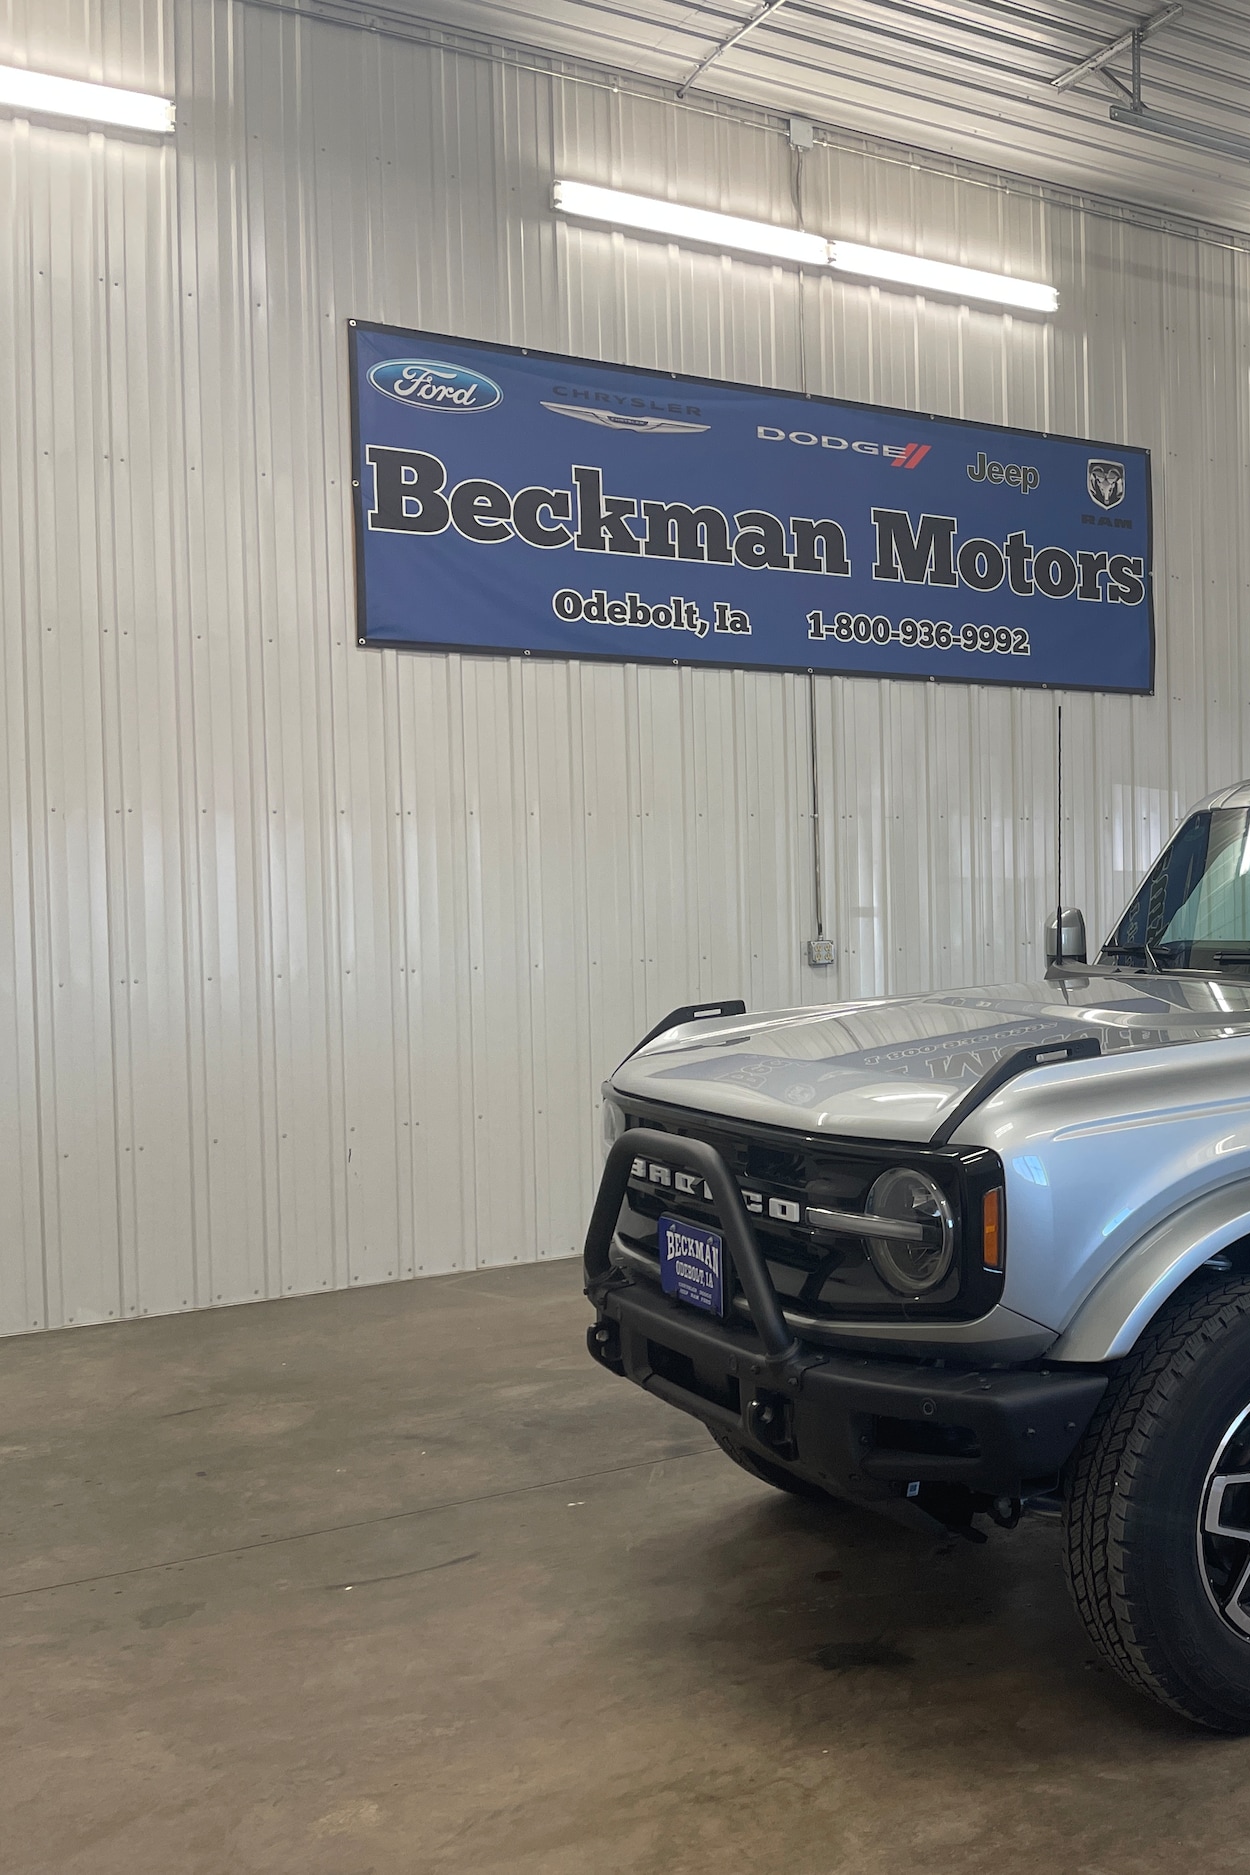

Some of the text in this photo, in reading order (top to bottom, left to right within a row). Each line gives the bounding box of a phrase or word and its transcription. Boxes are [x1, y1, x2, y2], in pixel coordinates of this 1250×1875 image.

[394, 365, 478, 406] Ford
[552, 385, 703, 417] CHRYSLER
[756, 426, 907, 459] DODGE
[966, 452, 1040, 494] Jeep
[365, 444, 1145, 606] Beckman Motors
[1081, 513, 1132, 529] RAM
[552, 588, 752, 638] Odebolt, Ia
[806, 610, 1030, 656] 1-800-936-9992
[631, 1157, 799, 1223] BROCO
[666, 1231, 719, 1278] BECKMAN
